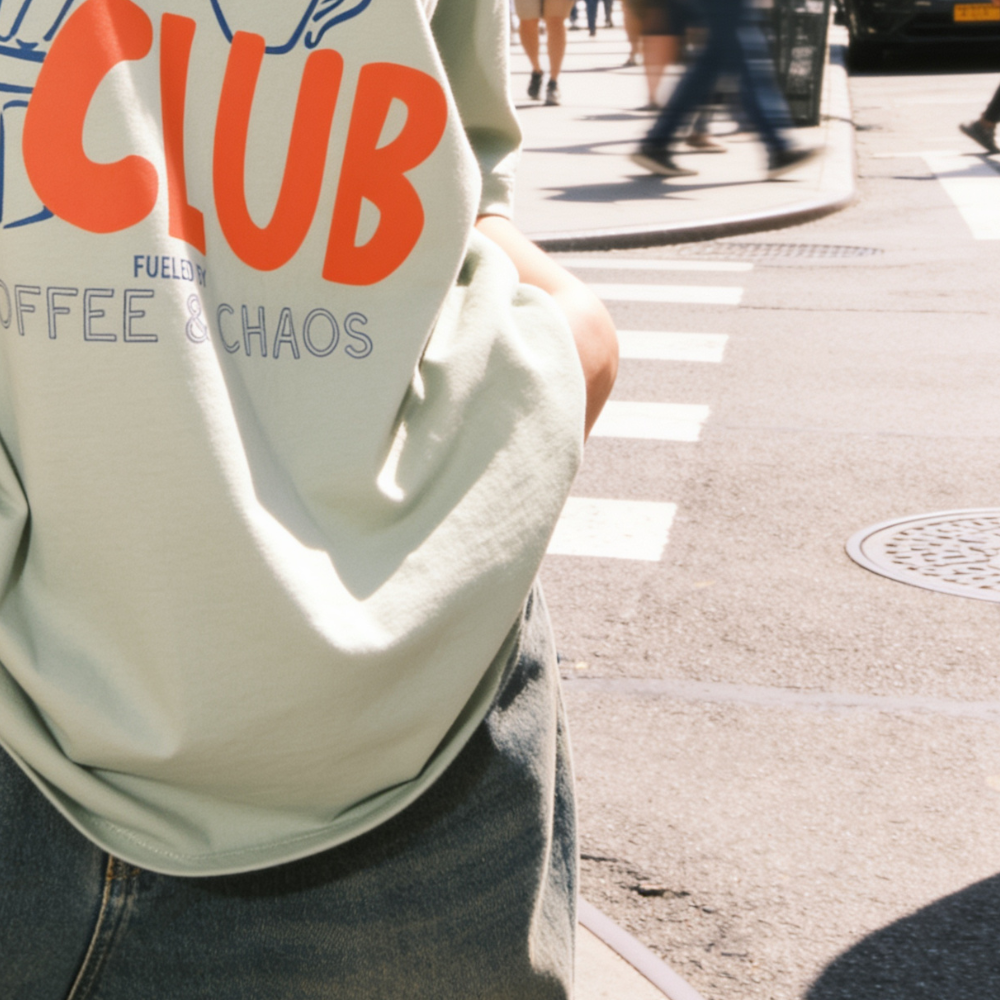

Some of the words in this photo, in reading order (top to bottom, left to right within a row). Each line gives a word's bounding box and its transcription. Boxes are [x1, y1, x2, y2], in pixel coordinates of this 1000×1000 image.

[134, 254, 194, 282] FUELED
[185, 293, 209, 344] &
[216, 303, 373, 360] CHAOS
